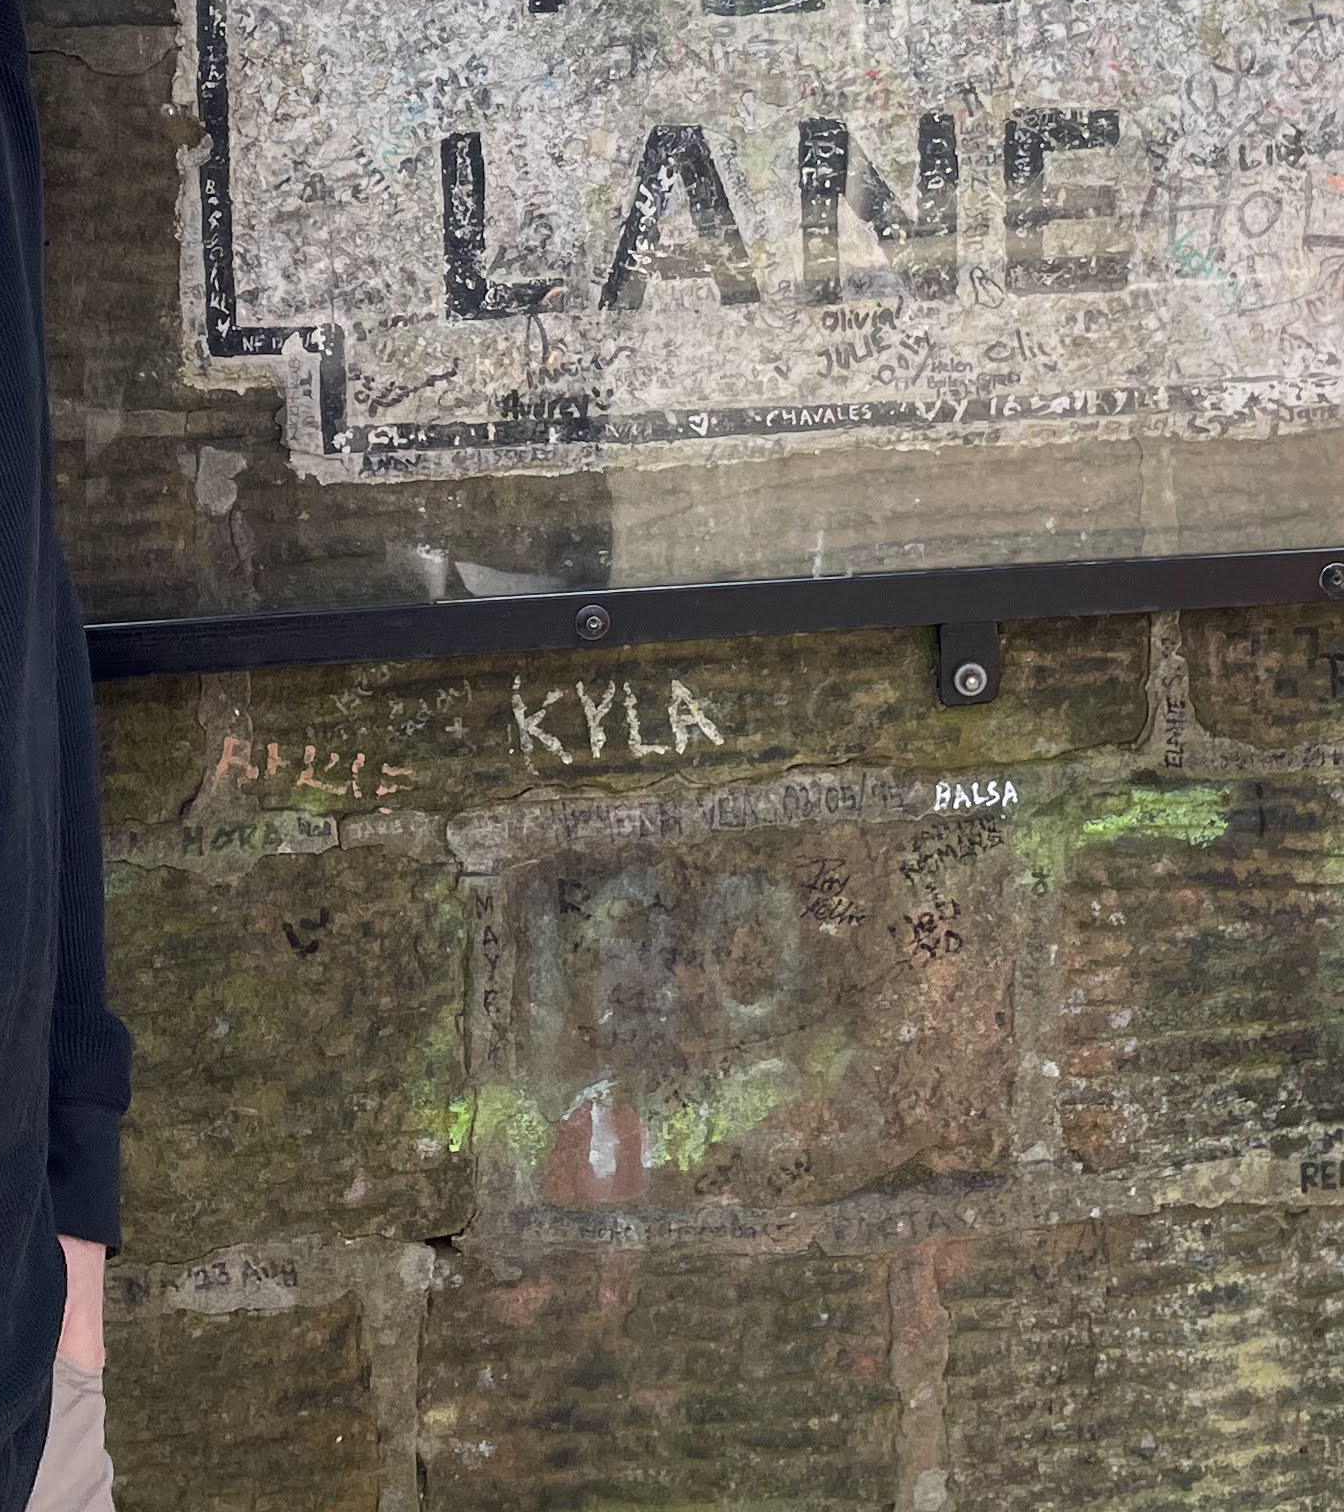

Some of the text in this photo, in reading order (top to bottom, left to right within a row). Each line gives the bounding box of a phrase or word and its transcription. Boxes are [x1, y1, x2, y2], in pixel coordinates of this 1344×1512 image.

[439, 107, 1131, 322] LANE
[766, 402, 873, 428] CHAVALES
[508, 674, 726, 776] KYLA
[934, 780, 1019, 811] BALSA
